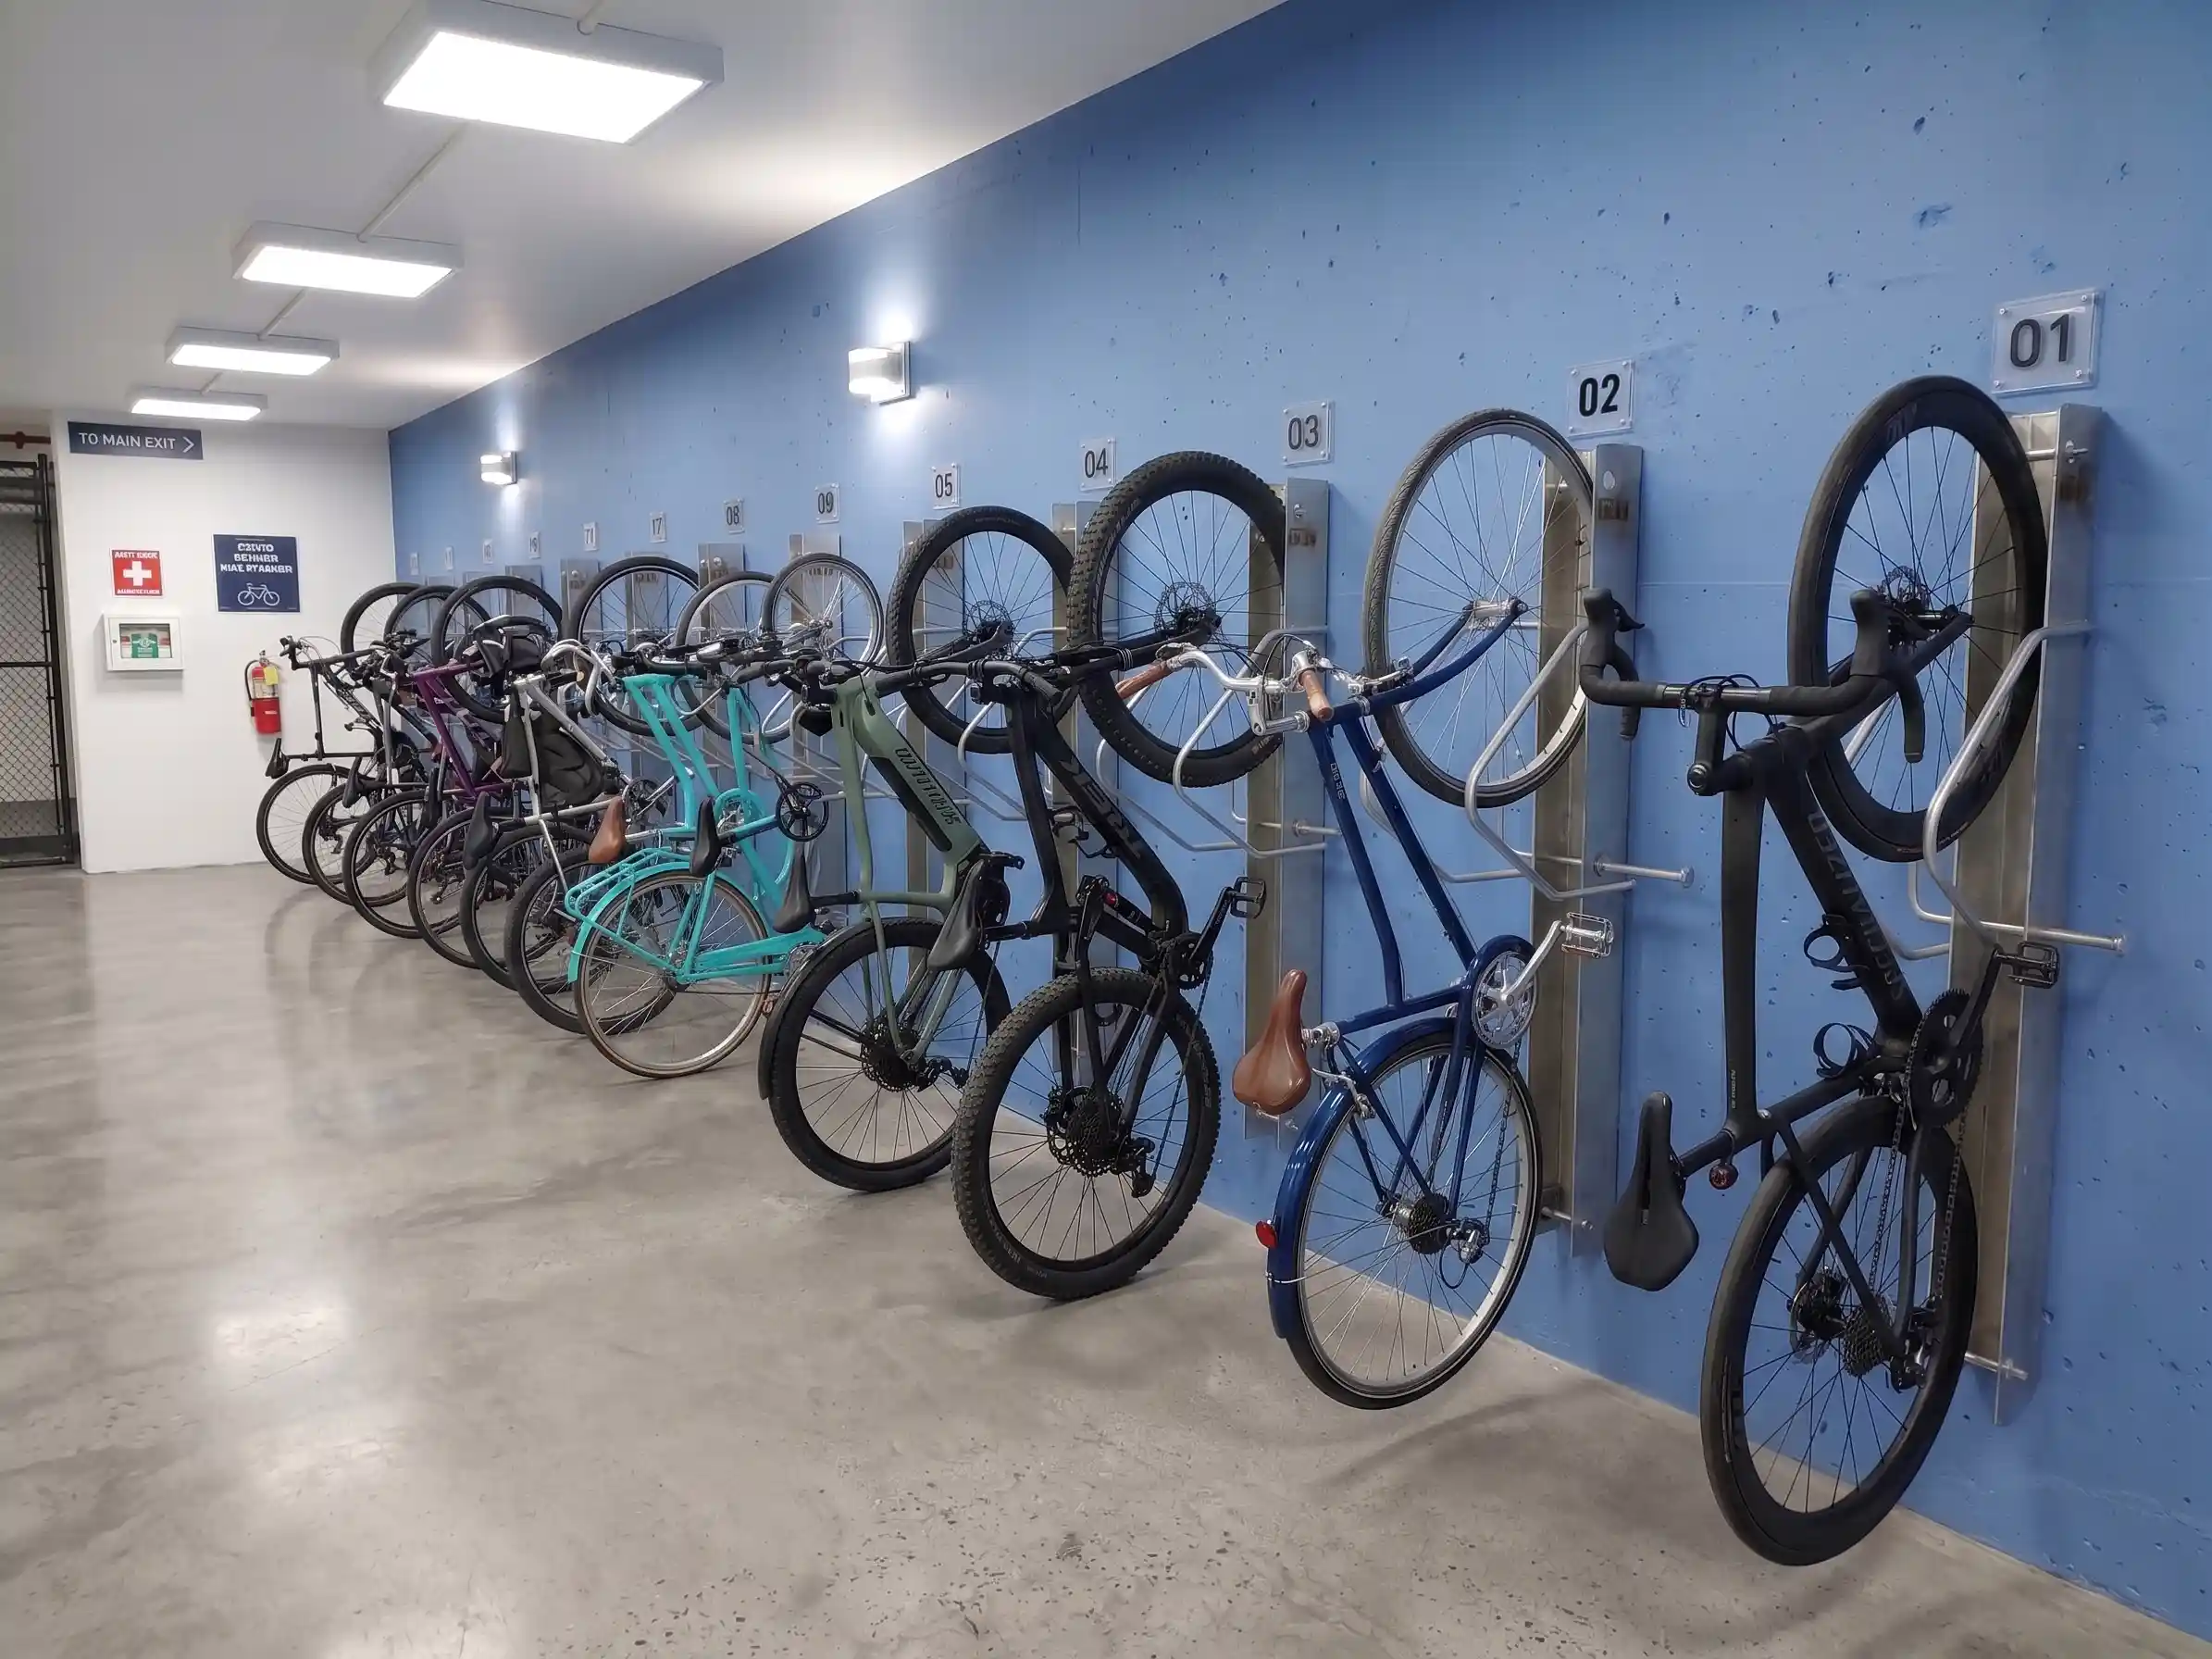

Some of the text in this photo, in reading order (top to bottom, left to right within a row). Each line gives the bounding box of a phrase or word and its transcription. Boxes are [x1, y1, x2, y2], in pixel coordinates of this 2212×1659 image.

[2010, 313, 2070, 368] 01
[1579, 373, 1621, 418] 02
[79, 432, 176, 450] TO MAIN EXIT
[1287, 414, 1319, 451] 03
[1084, 447, 1109, 479] 04
[935, 472, 953, 498] 05
[726, 505, 740, 526] 08
[817, 491, 834, 515] 09
